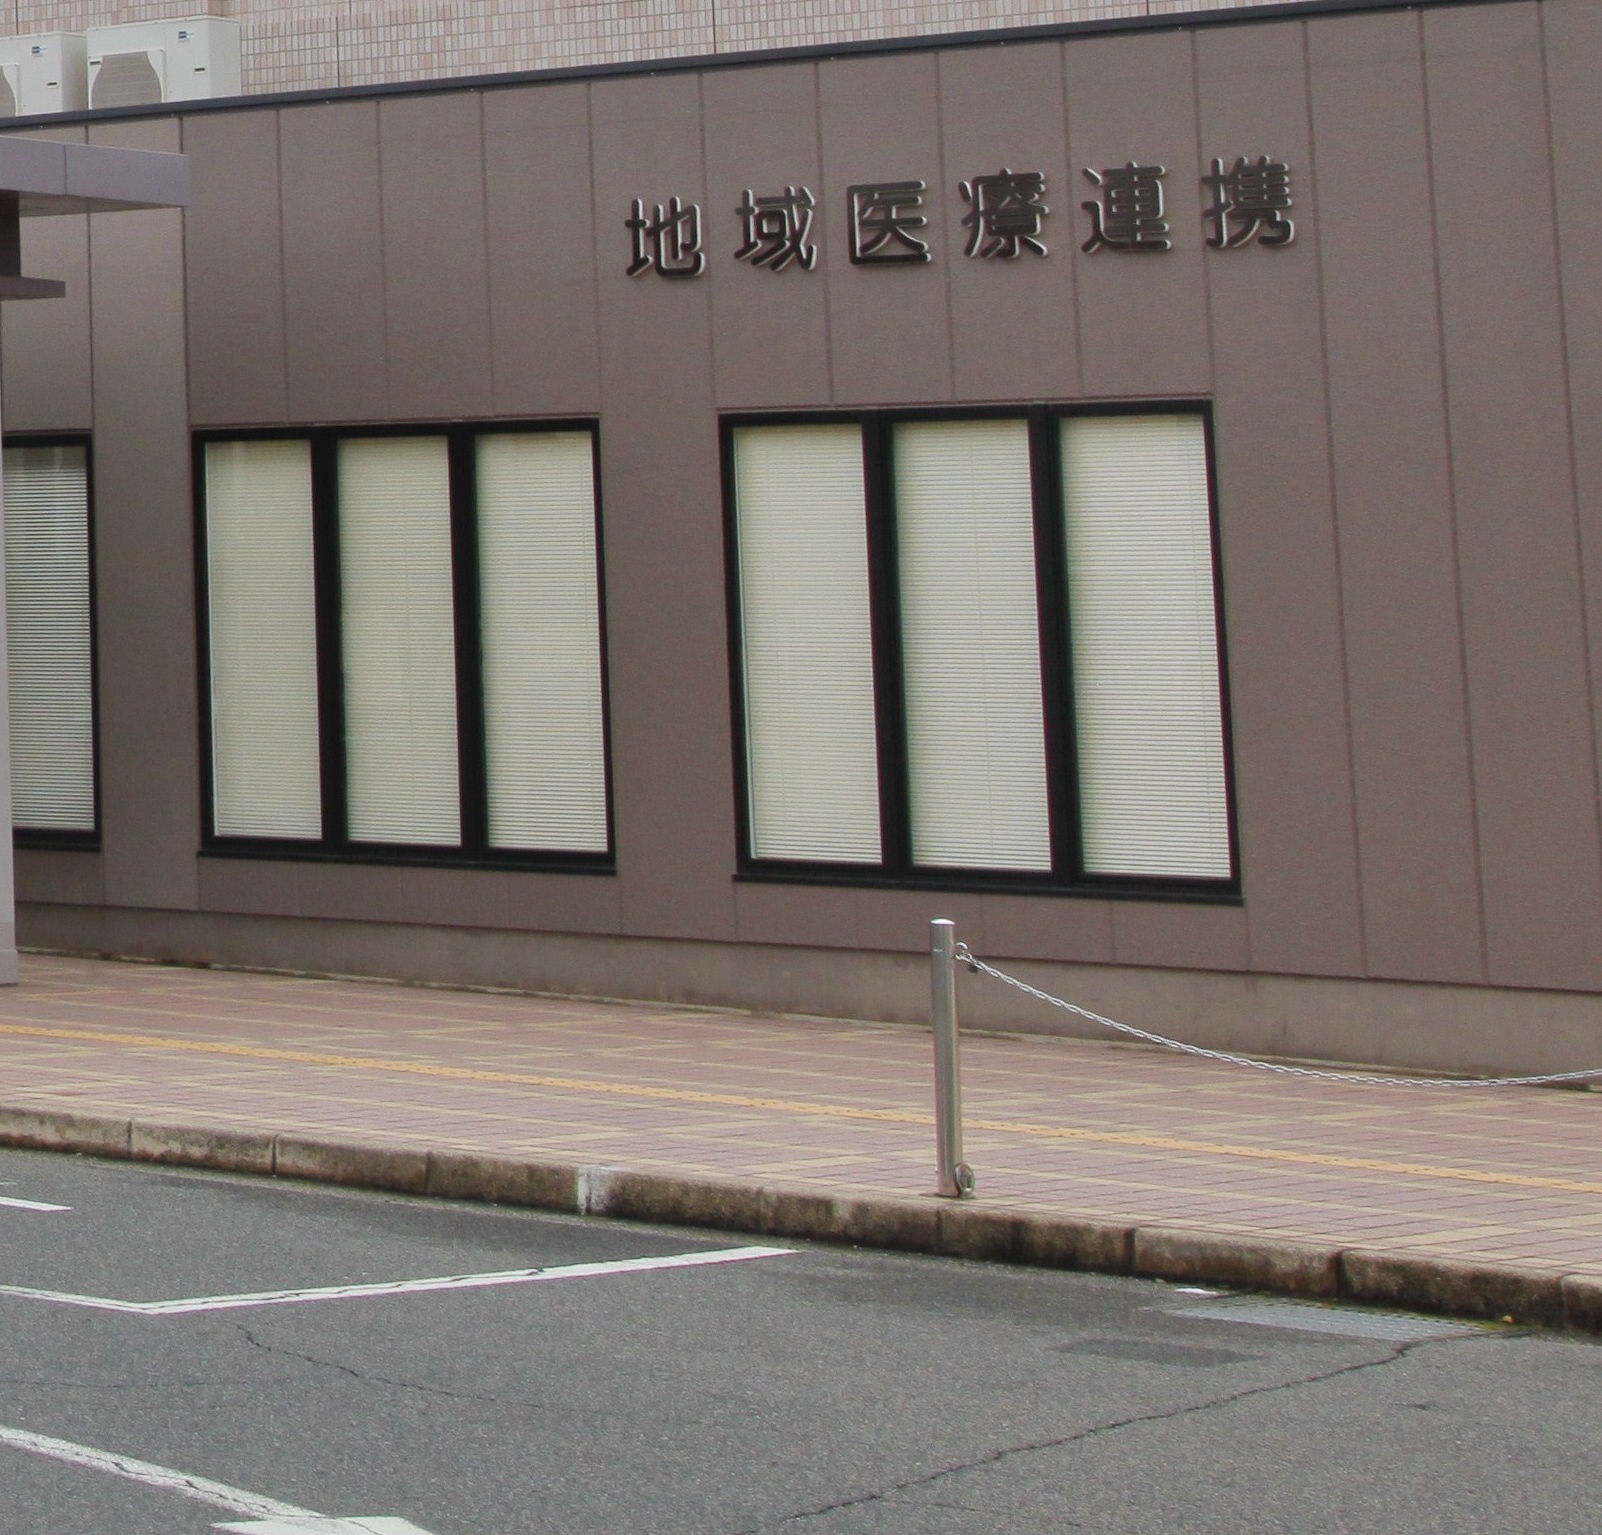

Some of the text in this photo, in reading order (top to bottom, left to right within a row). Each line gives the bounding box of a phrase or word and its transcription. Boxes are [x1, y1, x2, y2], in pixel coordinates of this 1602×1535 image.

[625, 154, 1296, 278] 地域医療連携
